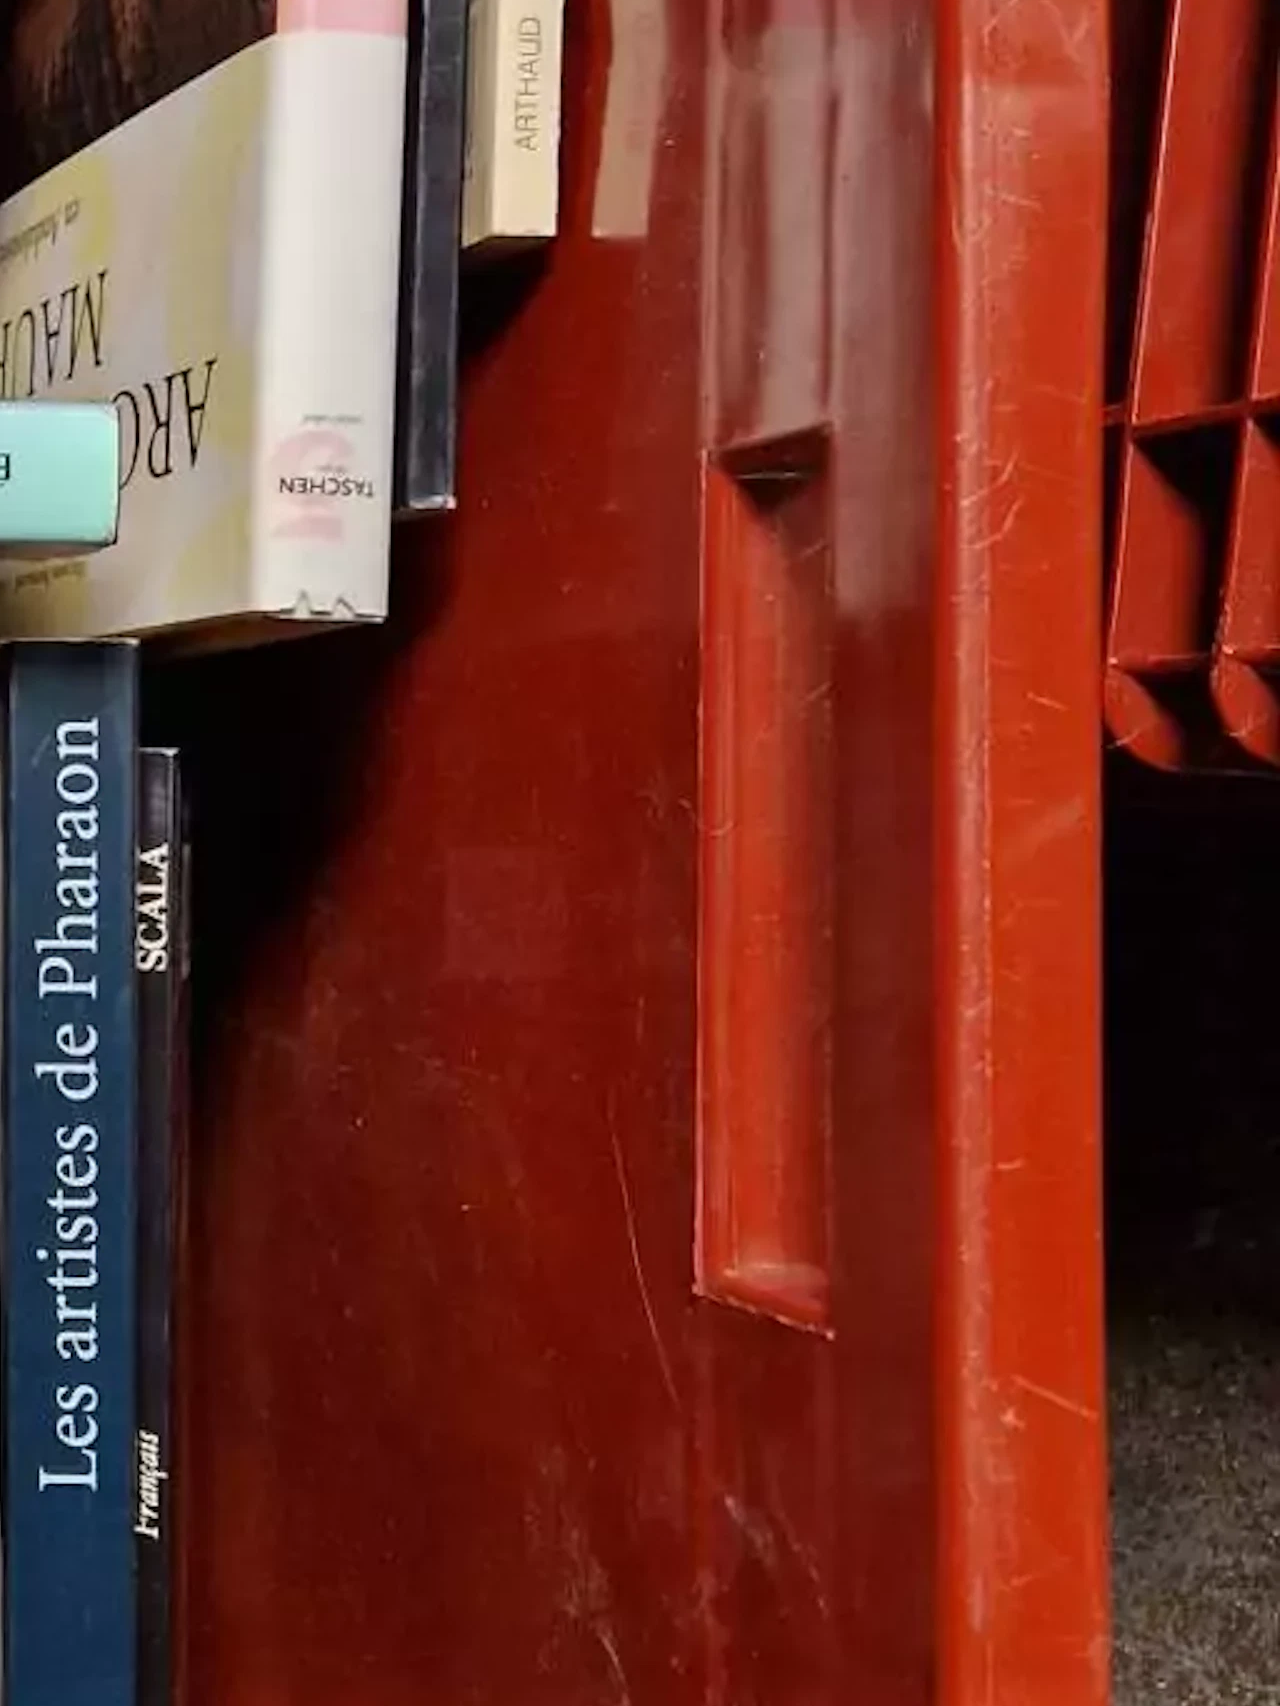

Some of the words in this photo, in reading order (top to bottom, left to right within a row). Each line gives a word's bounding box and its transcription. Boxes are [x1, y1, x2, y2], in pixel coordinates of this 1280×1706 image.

[511, 15, 543, 153] ARTHAUD
[278, 475, 374, 499] TASCHEN
[32, 718, 100, 999] Pharaon
[133, 841, 170, 974] SCALA
[30, 1019, 100, 1102] de
[34, 1122, 100, 1363] artistes
[35, 1382, 100, 1494] Les
[132, 1428, 170, 1540] Français
